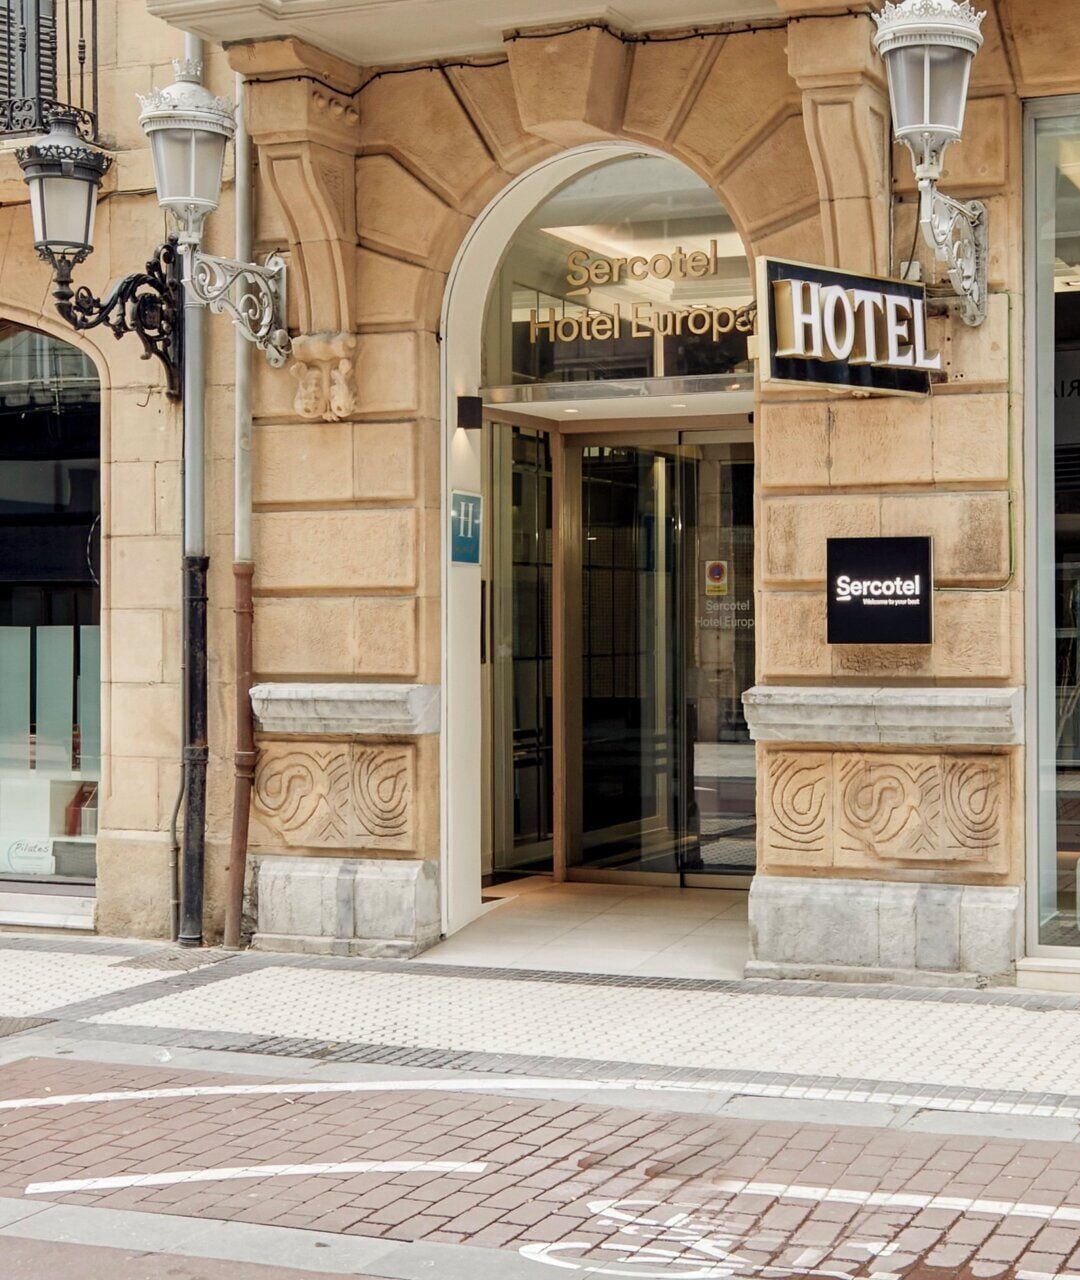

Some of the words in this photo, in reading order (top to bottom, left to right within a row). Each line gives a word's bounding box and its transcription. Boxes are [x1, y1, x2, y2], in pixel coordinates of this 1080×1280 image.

[566, 239, 718, 286] Sercotel
[529, 303, 620, 344] Hotel
[631, 301, 757, 342] Europa
[783, 278, 941, 370] HOTEL
[458, 501, 474, 538] H
[837, 574, 920, 596] Sercotel
[695, 616, 722, 628] Hotel
[724, 615, 755, 629] Europ
[705, 600, 750, 611] Sercotel
